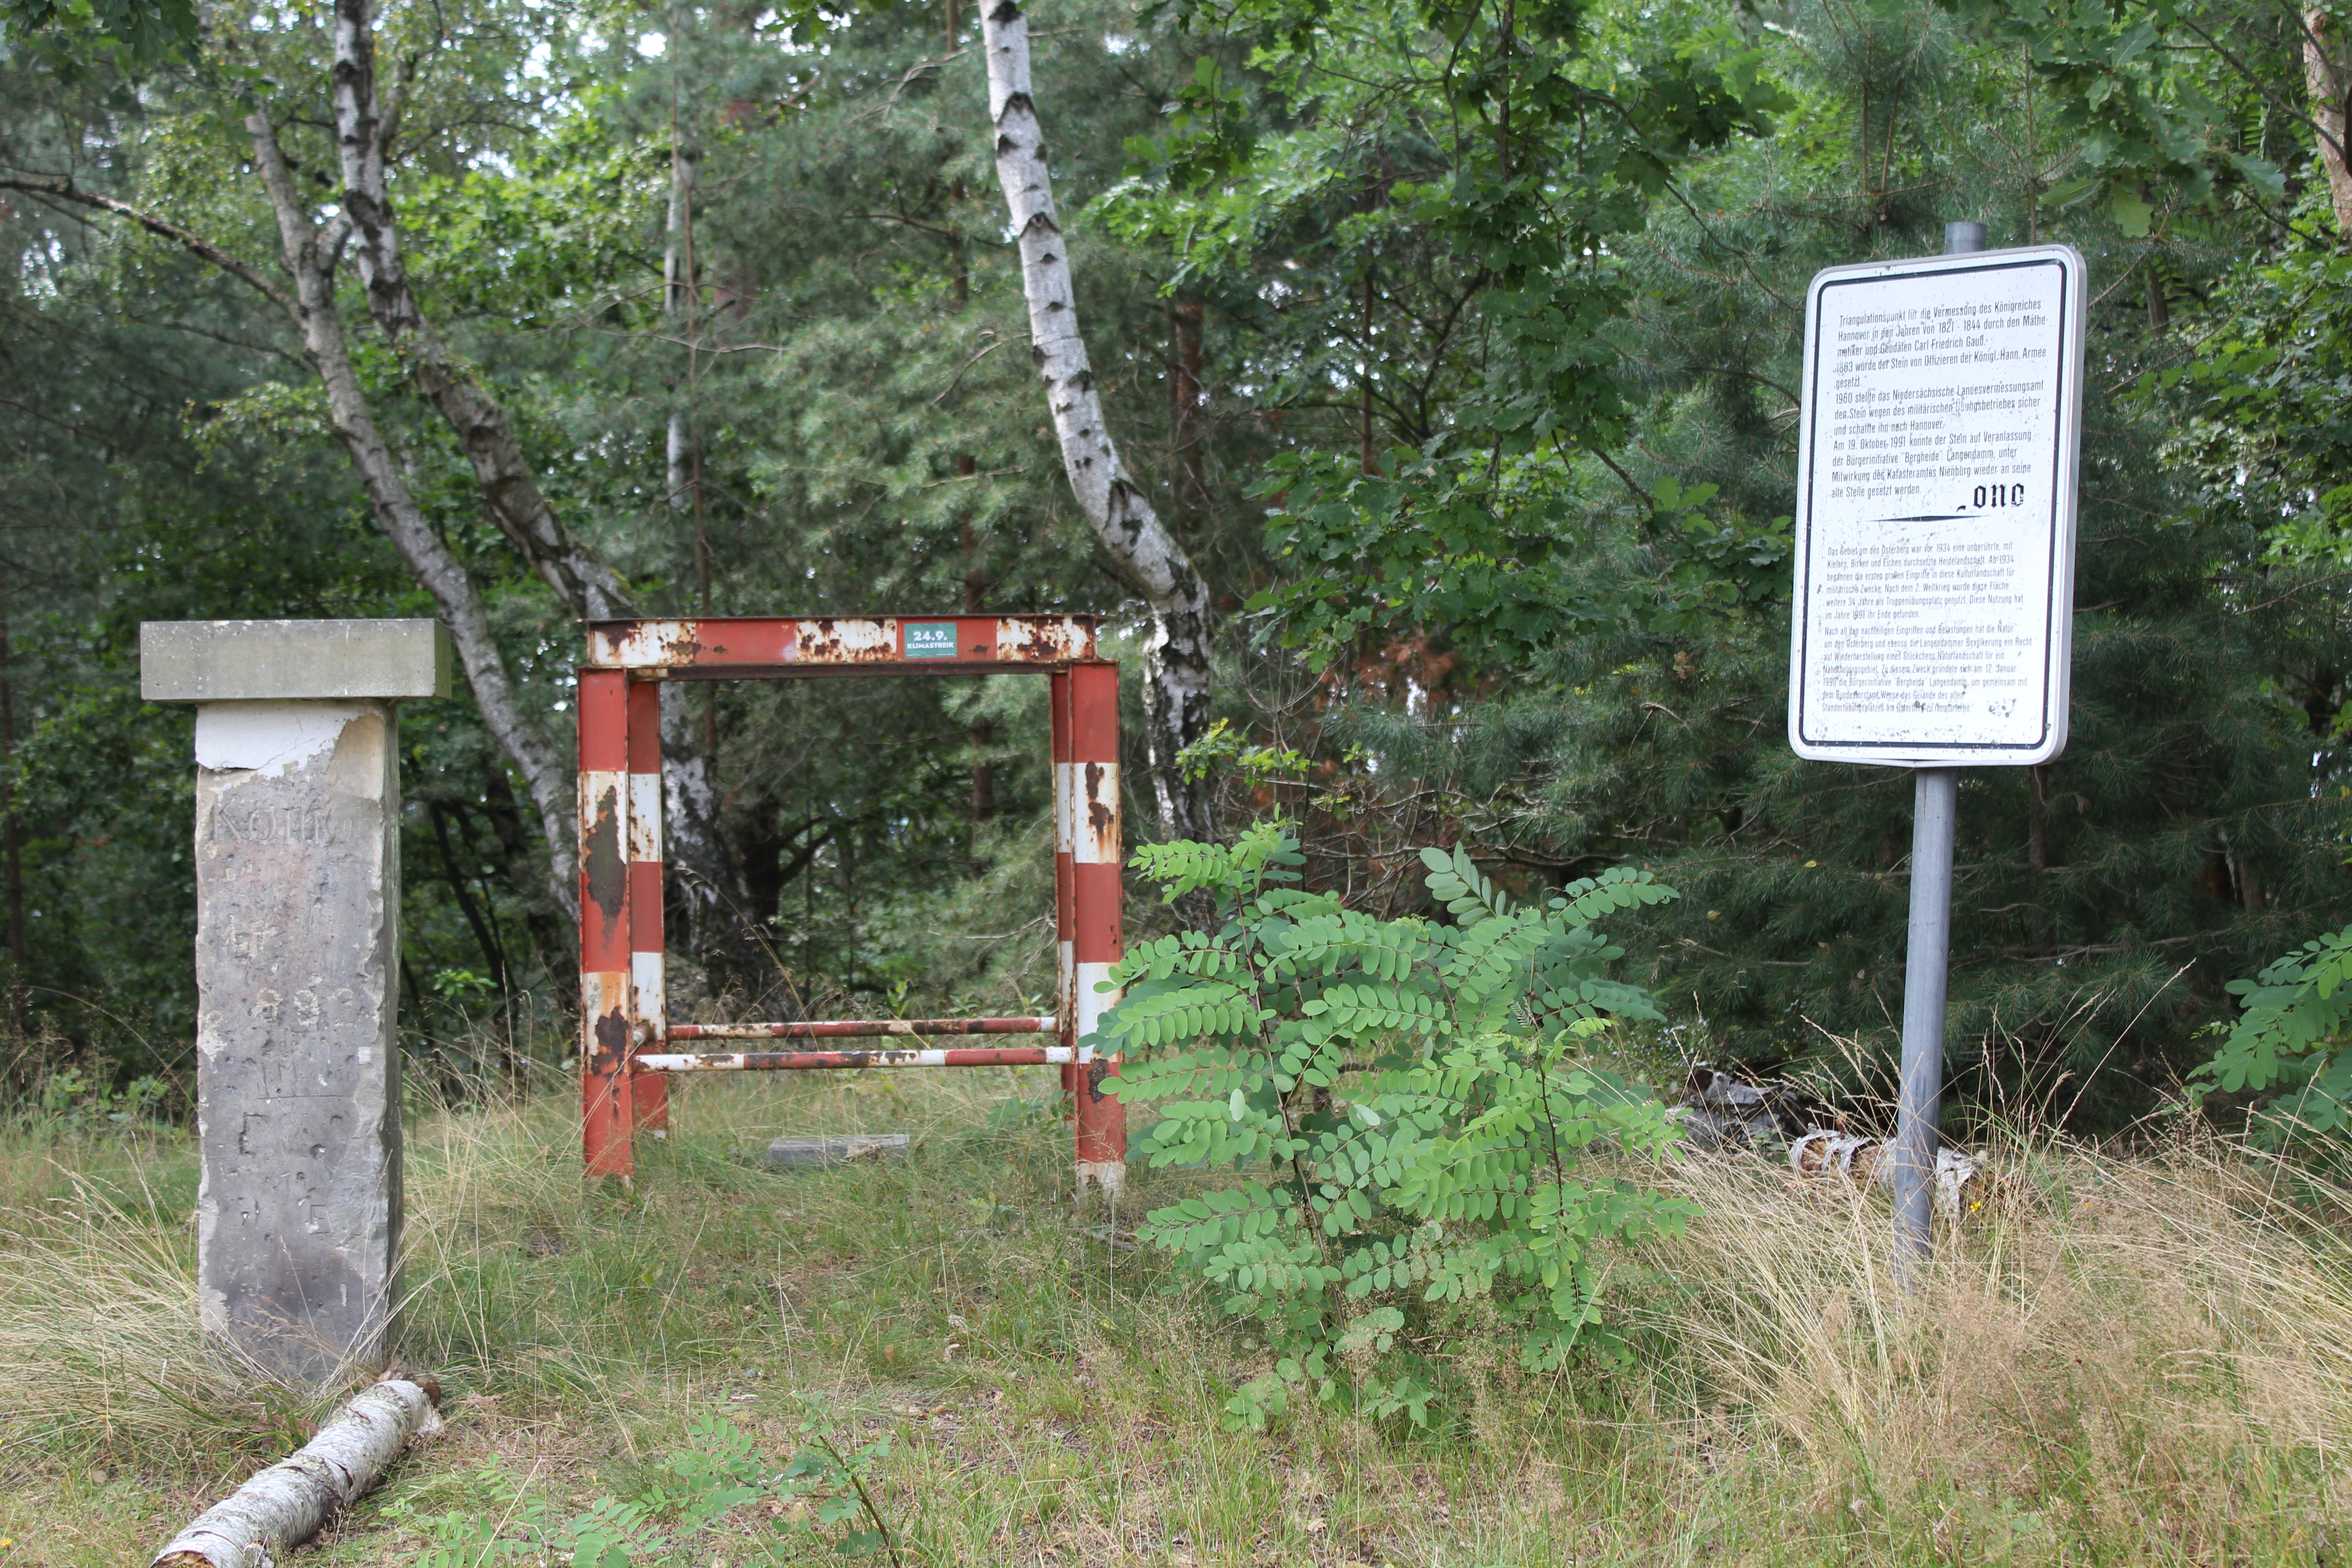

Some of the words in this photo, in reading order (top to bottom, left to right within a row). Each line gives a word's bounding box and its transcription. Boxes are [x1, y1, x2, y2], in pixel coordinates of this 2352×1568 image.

[1839, 309, 1905, 328] Triangulationspunkt
[1920, 307, 1931, 319] die
[1933, 303, 1976, 320] Vermessung
[1979, 301, 1992, 314] des
[1994, 297, 2041, 314] Königreiches
[1838, 328, 1870, 342] Hannover
[1896, 323, 1920, 337] Jahren
[1922, 325, 1935, 335] von
[1939, 321, 1954, 333] 1821
[1964, 318, 1980, 331] 1844
[1983, 316, 2004, 330] durch
[2007, 315, 2020, 328] den
[2023, 312, 2048, 326] Mathe-
[1914, 338, 1929, 351] Carl
[1931, 336, 1963, 350] Friedrich
[1965, 333, 1986, 347] Gauß.
[1855, 358, 1876, 372] wurde
[1891, 356, 1908, 369] Stein
[1910, 358, 1922, 368] von
[1924, 352, 1958, 366] Offizieren
[1960, 351, 1972, 363] der
[2022, 345, 2046, 359] Armee
[1836, 392, 1852, 404] 1960
[1878, 389, 1890, 402] das
[1892, 384, 1954, 401] Niedersächsische
[1849, 407, 1866, 419] Stein
[1868, 407, 1890, 419] wegen
[1893, 404, 1905, 416] des
[1907, 401, 1955, 415] militärischen
[2018, 395, 2040, 408] sicher
[1834, 423, 1846, 436] und
[1848, 421, 1875, 435] schaffte
[1891, 420, 1907, 432] nach
[1833, 439, 1844, 451] Am
[1891, 436, 1905, 448] 1991
[1909, 434, 1932, 447] konnte
[1935, 433, 1946, 446] der
[1949, 432, 1967, 445] Stein
[1970, 431, 1980, 443] auf
[1983, 428, 2031, 444] Veranlassung
[1832, 455, 1843, 467] der
[1846, 452, 1898, 468] Bürgerinitiative
[1999, 445, 2017, 458] unter
[1832, 469, 1870, 484] Mitwirkung
[1887, 466, 1936, 480] Katasteramtes
[1939, 464, 1971, 479] Nienburg
[1974, 462, 1998, 475] wieder
[2000, 464, 2009, 474] an
[2012, 461, 2031, 473] seine
[1831, 486, 1843, 498] alte
[1846, 485, 1865, 497] Stelle
[1867, 484, 1891, 498] gesetzt
[1828, 546, 1838, 556] Das
[1869, 545, 1879, 554] den
[1881, 544, 1909, 555] Osterberg
[1936, 543, 1950, 553] 1934
[1952, 542, 1965, 552] eine
[2003, 540, 2012, 550] mit
[1851, 559, 1869, 568] Birken
[1871, 558, 1881, 568] und
[1883, 557, 1901, 567] Eichen
[1903, 556, 1936, 567] durchsetzte
[1999, 554, 2014, 564] 1934
[1827, 571, 1852, 583] begannen
[1906, 569, 1930, 581] Eingriffe
[1931, 569, 1937, 578] in
[1939, 568, 1954, 578] diese
[1956, 567, 2004, 578] Kulturlandschaft
[2006, 567, 2014, 577] für
[1885, 583, 1899, 593] Nach
[1901, 583, 1913, 592] dem
[1923, 582, 1950, 593] Weltkrieg
[1952, 581, 1970, 591] wurde
[1989, 580, 2009, 590] Fläche
[1826, 597, 1846, 607] weitere
[1848, 597, 1855, 607] 34
[1857, 597, 1874, 606] Jahre
[1876, 596, 1884, 606] als
[1886, 595, 1942, 607] Truppenübungsplatz
[1969, 594, 1985, 604] Diese
[1988, 593, 2012, 605] Nutzung
[2014, 593, 2023, 603] hat
[1825, 610, 1832, 619] im
[1833, 610, 1850, 619] Jahre
[1877, 609, 1891, 619] Ende
[913, 631, 947, 642] 24.9.
[1824, 626, 1838, 635] Nach
[1861, 625, 1894, 636] nachteiligen
[1896, 625, 1923, 636] Eingriffen
[1925, 624, 1936, 634] und
[1938, 624, 1973, 635] Belastungen
[1975, 624, 1984, 633] hat
[1986, 623, 1995, 633] die
[1997, 623, 2013, 633] Natur
[1846, 638, 1873, 649] Osterberg
[1875, 638, 1885, 648] und
[1887, 638, 1907, 647] ebenso
[1920, 637, 1963, 648] Langendammer
[1966, 637, 2002, 648] Bevölkerung
[2004, 637, 2013, 647] ein
[2015, 637, 2032, 647] Recht
[1823, 652, 1832, 661] auf
[1834, 651, 1884, 662] Wiederherstellung
[1903, 651, 1936, 660] Stückchens
[1937, 650, 1983, 660] Naturlandschaft
[1985, 650, 1993, 660] für
[1995, 650, 2004, 660] ein
[1912, 664, 1931, 673] Zweck
[1932, 663, 1957, 675] gründete
[1960, 663, 1971, 673] sich
[1995, 663, 2016, 673] Januar
[1823, 677, 1838, 686] 1990
[1837, 677, 1847, 686] die
[1982, 676, 2015, 687] gemeinsam
[2018, 676, 2027, 686] mit
[1899, 690, 1911, 699] das
[1938, 690, 1948, 700] des
